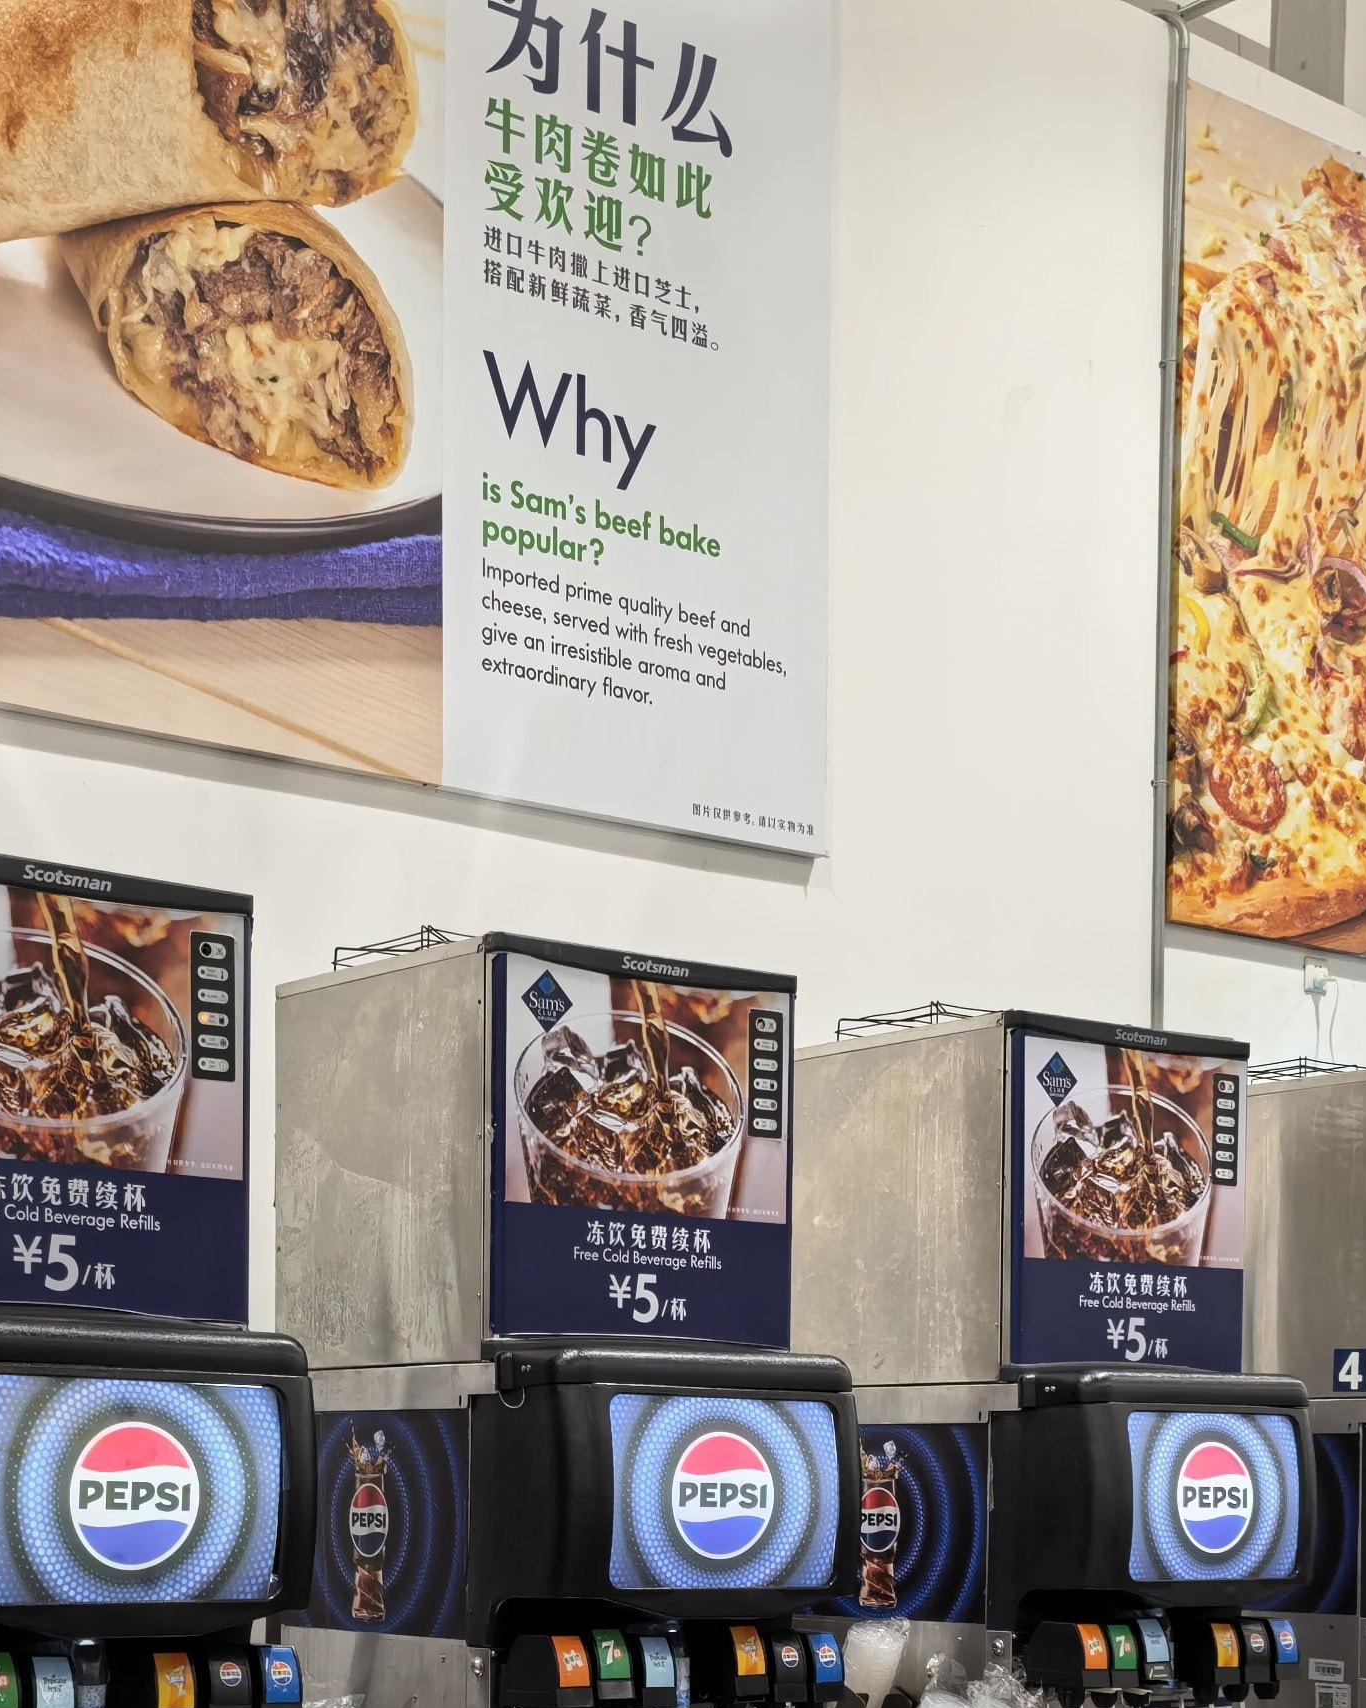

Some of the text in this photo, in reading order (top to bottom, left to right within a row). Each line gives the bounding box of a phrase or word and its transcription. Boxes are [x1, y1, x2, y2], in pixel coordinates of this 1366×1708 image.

[486, 0, 733, 158] 为什么
[485, 97, 712, 219] 牛肉卷如此
[483, 349, 656, 491] Why
[510, 480, 721, 558] Sam's beef bake
[482, 519, 604, 565] popular?
[482, 558, 716, 629] Imported prime quality beef
[481, 594, 787, 676] cheese, served fresh vegetables,
[481, 624, 690, 683] give irresistible aroma
[481, 655, 653, 705] extraordinary flavor.
[22, 864, 112, 892] Scotsman
[622, 955, 689, 978] Scotsman
[529, 990, 565, 1013] Sam's
[537, 1008, 558, 1017] CLUB
[1115, 1029, 1167, 1046] Scotsman
[1042, 1071, 1071, 1090] Sam's
[4, 1204, 39, 1222] Cold
[44, 1207, 115, 1231] Beverage
[120, 1212, 160, 1231] Refills
[587, 1220, 711, 1253] 冻饮免费续杯
[1090, 1272, 1187, 1298] 冻饮免费续杯
[1079, 1295, 1195, 1313] Free Cold Beverage Refills
[1338, 1352, 1362, 1390] 4
[78, 1479, 191, 1512] PEPSI
[679, 1482, 767, 1509] PEPSI
[1183, 1486, 1248, 1510] PEPSI
[351, 1511, 387, 1529] PEPSI
[860, 1512, 897, 1528] PEPSI
